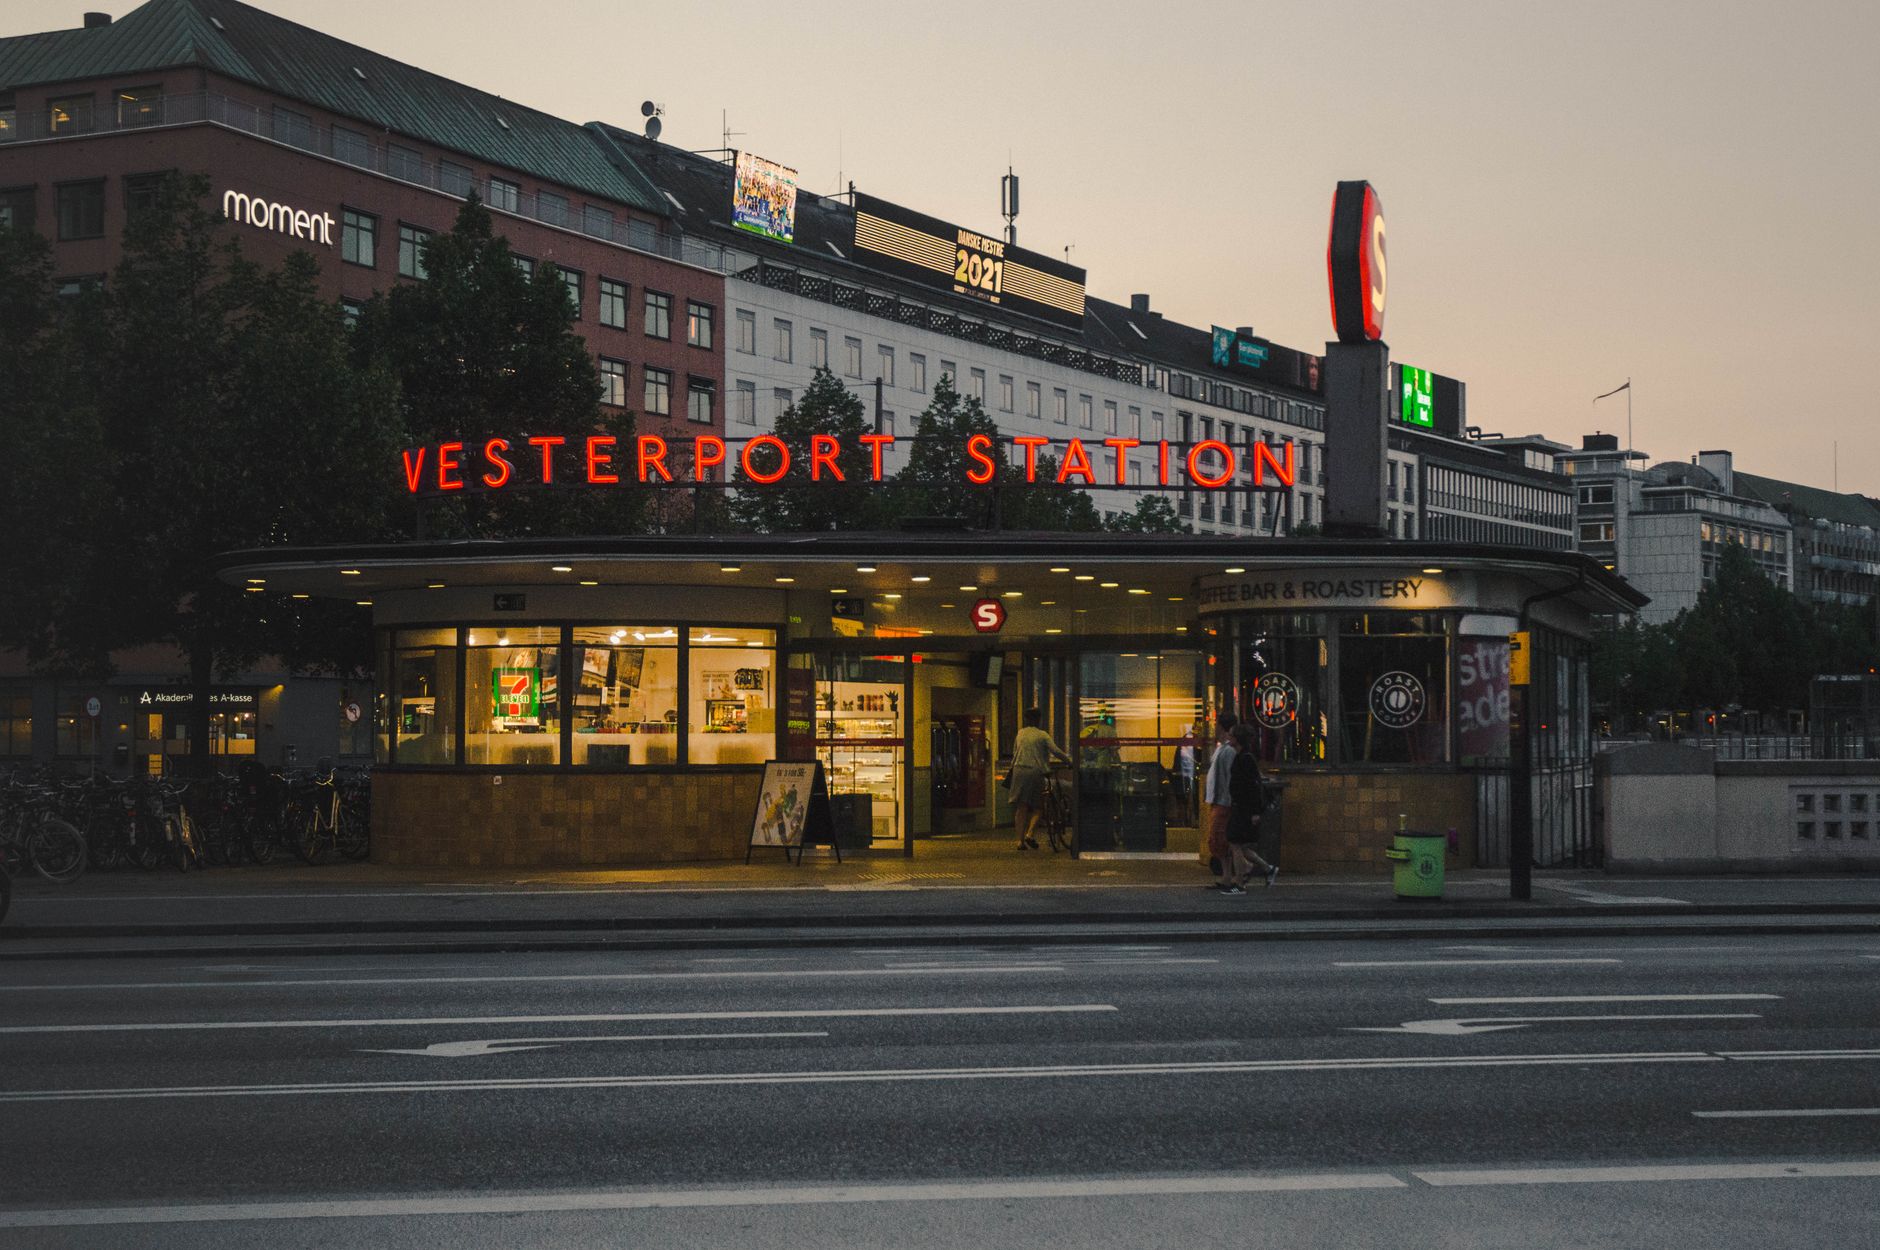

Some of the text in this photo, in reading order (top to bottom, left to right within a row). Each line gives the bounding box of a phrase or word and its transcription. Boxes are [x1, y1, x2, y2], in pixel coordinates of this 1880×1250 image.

[223, 190, 335, 245] moment
[957, 229, 1005, 258] DANSKE MESTRE
[954, 249, 1003, 294] 2021
[1371, 214, 1387, 313] S
[403, 433, 1295, 493] VESTERPORT STATION
[1241, 582, 1277, 601] BAR
[1282, 581, 1296, 600] &
[1302, 579, 1423, 599] ROASTERY
[978, 603, 998, 627] S
[220, 693, 253, 703] A-kasse
[500, 675, 530, 717] 7
[1375, 675, 1420, 694] ROAST
